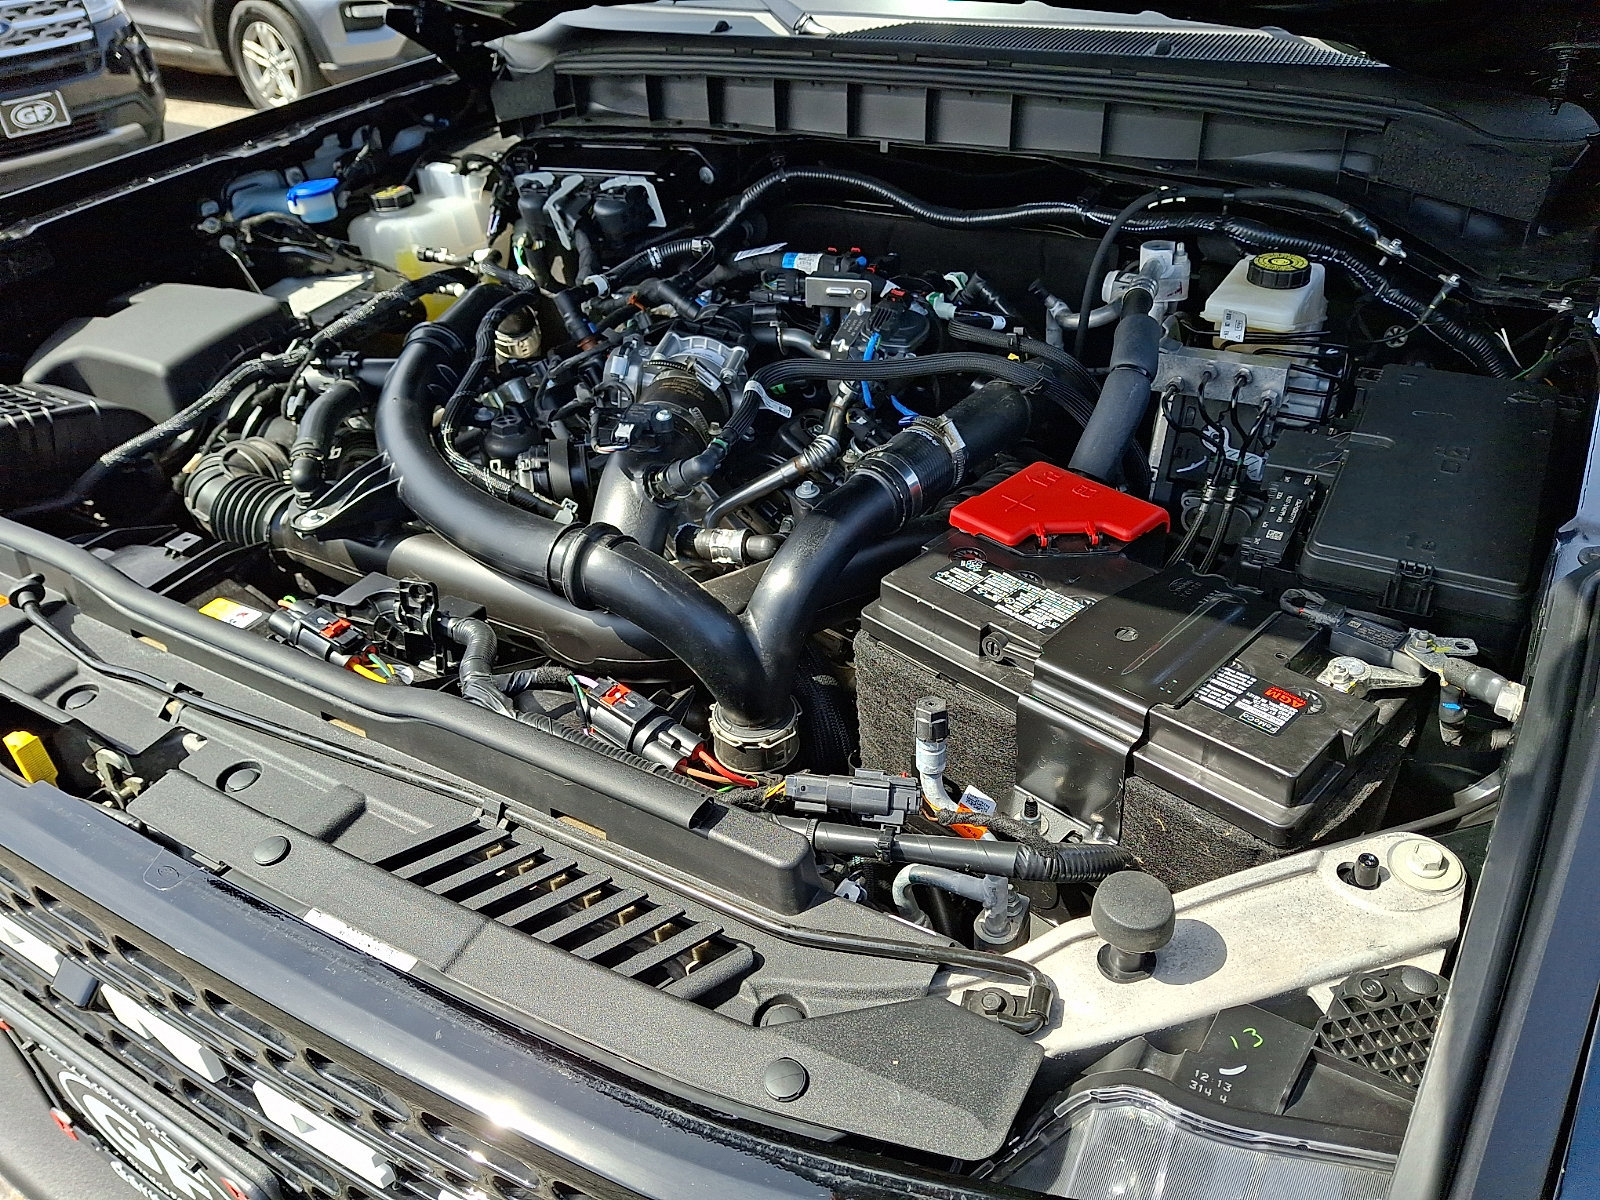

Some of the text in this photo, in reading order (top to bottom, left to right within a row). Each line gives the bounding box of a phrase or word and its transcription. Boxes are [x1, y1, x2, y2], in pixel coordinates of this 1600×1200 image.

[1264, 689, 1304, 708] AGM
[1241, 712, 1278, 731] FoMoCo
[1230, 1027, 1264, 1050] 13
[1188, 1080, 1213, 1097] 314
